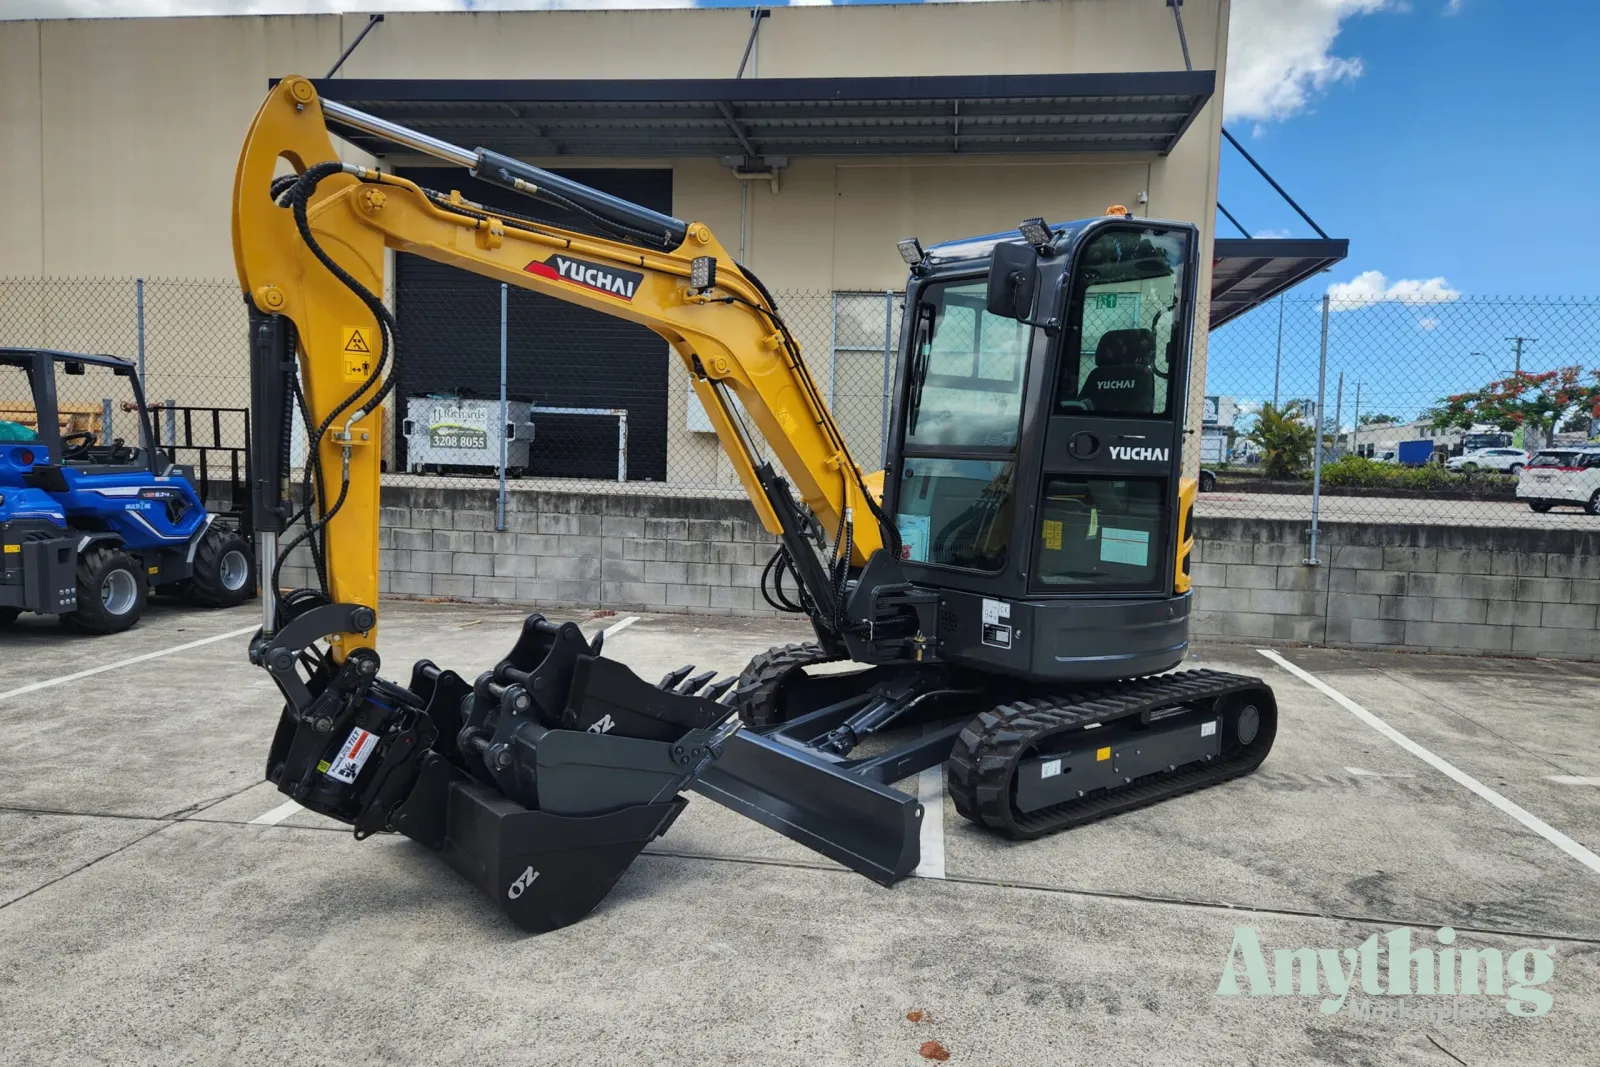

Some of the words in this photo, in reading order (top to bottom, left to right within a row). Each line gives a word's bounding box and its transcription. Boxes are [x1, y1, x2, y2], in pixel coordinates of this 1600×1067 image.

[556, 257, 634, 298] YUCHAI
[1097, 380, 1135, 389] YUCHAI
[433, 436, 457, 446] 3208
[460, 437, 484, 447] 8055
[1109, 446, 1169, 461] YUCHAI
[508, 866, 540, 899] OZ
